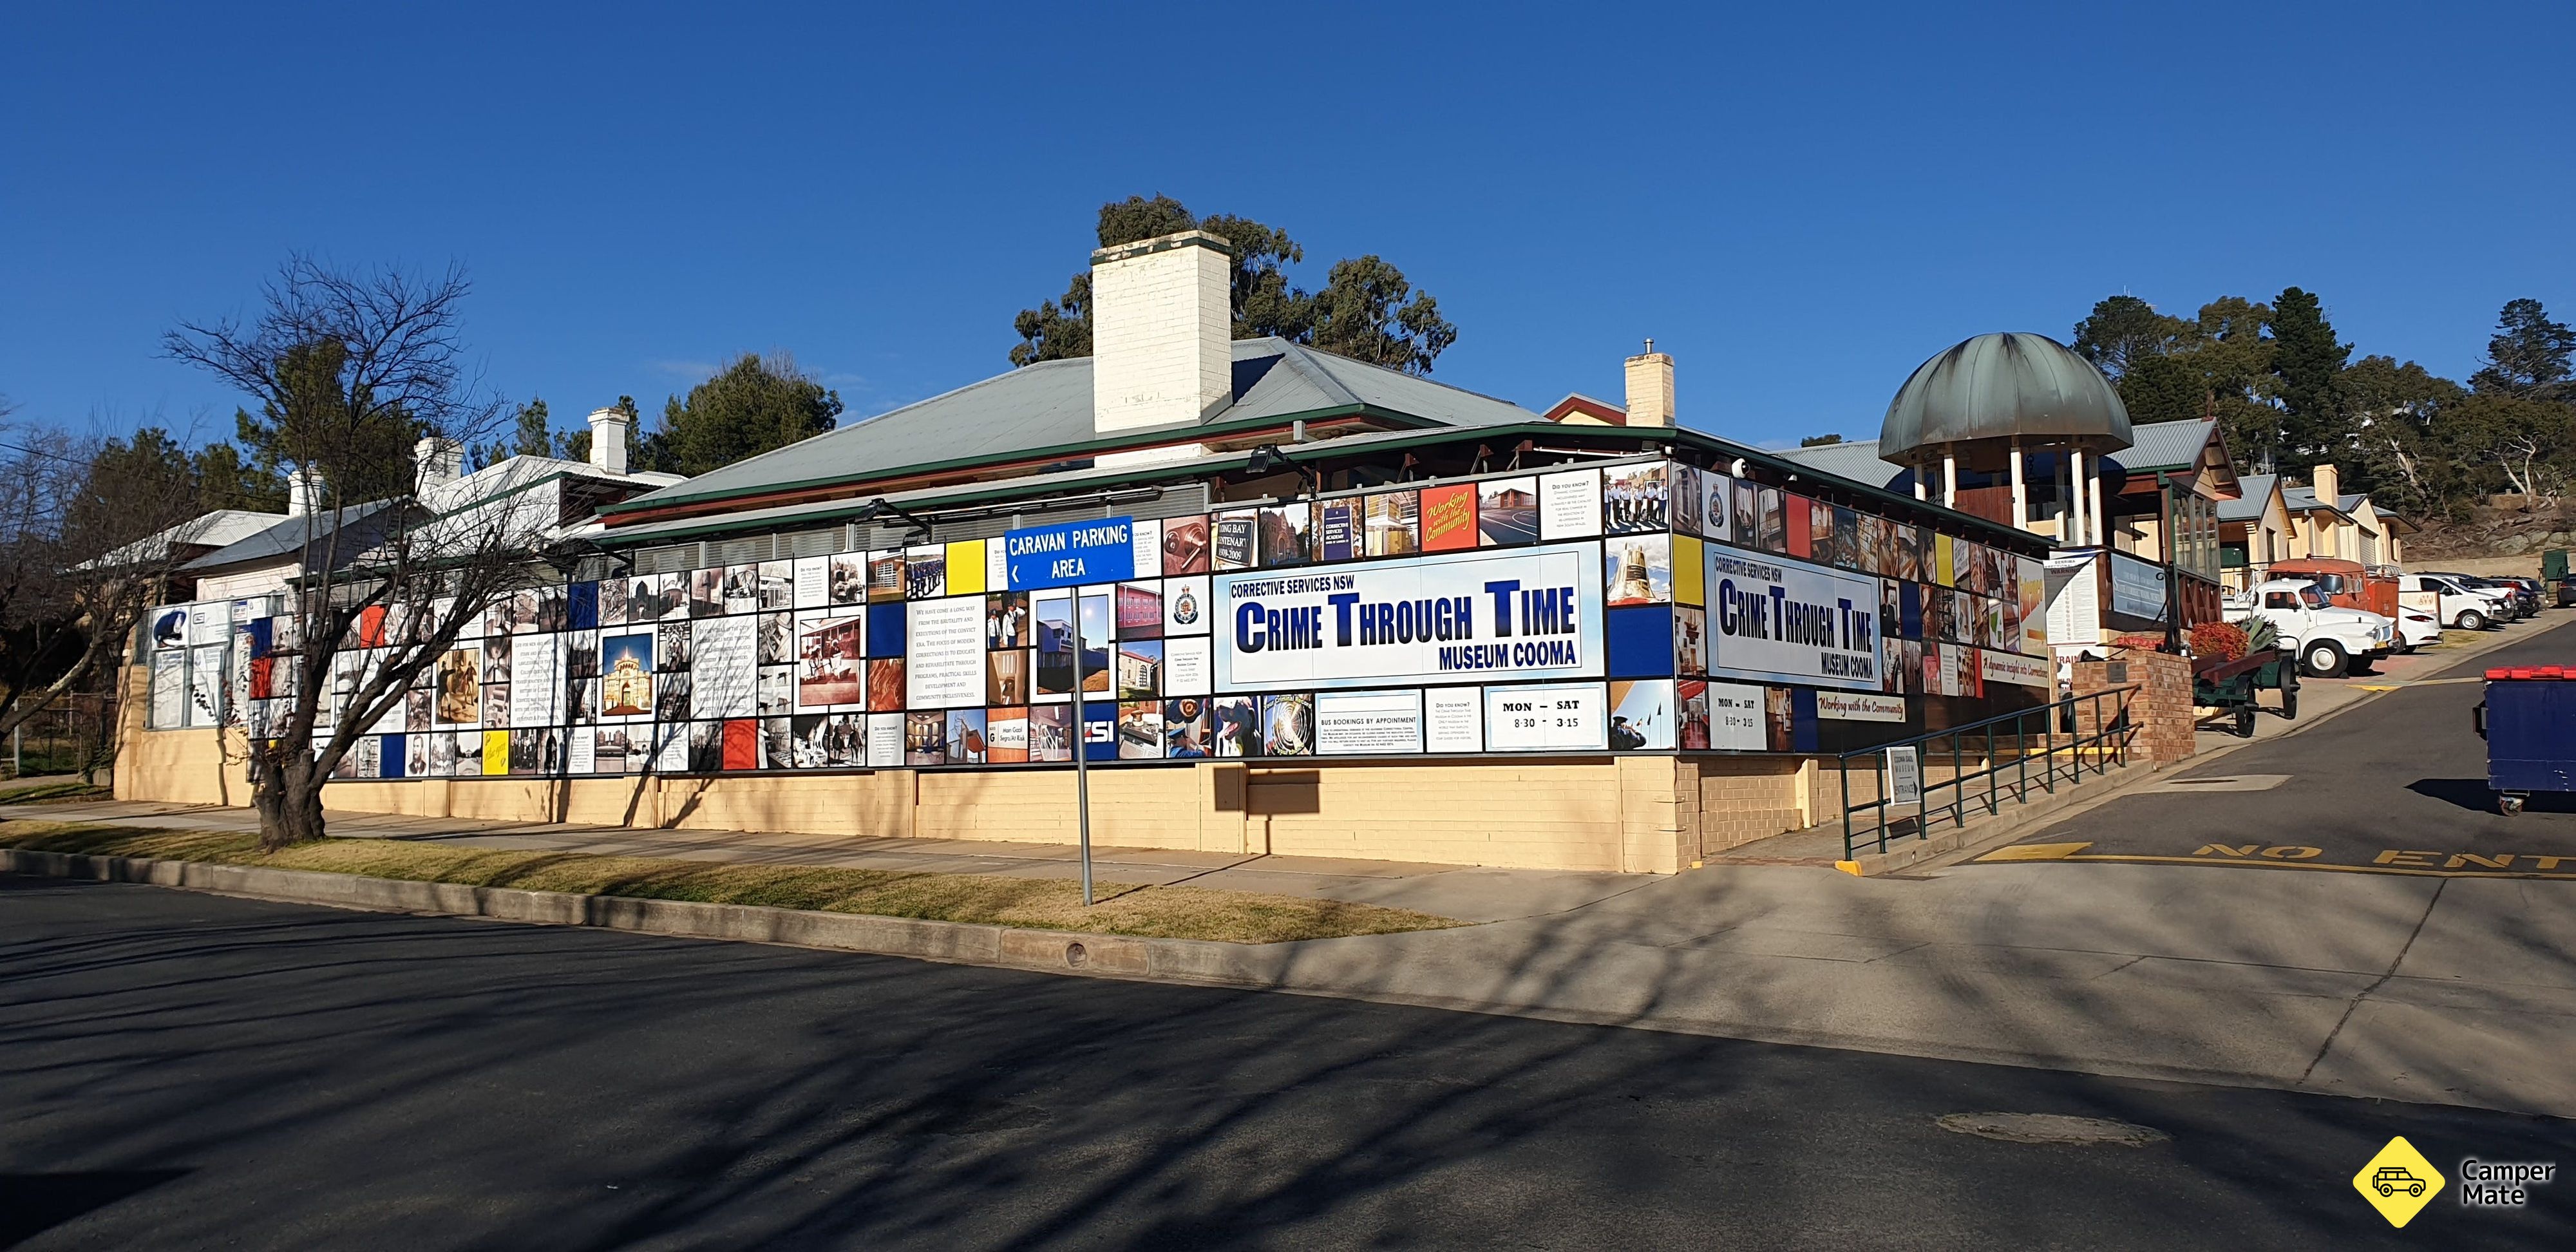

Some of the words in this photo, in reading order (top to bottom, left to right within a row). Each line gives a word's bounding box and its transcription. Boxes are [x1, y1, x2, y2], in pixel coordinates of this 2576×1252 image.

[1426, 491, 1468, 519] Working
[1434, 510, 1448, 527] with
[1450, 506, 1461, 519] the
[1220, 524, 1232, 533] LONG
[1232, 524, 1247, 534] BAY
[1426, 508, 1470, 542] Community
[1010, 532, 1066, 556] CARAVAN
[1073, 524, 1128, 549] PARKING
[1052, 558, 1086, 579] AREA
[1715, 556, 1747, 577] CORRECTIVE
[1747, 562, 1770, 582] SERVICES
[1770, 567, 1783, 583] NSW
[1231, 582, 1285, 599] CORRECTIVE
[1287, 578, 1331, 594] SERVICES
[1332, 574, 1354, 590] NSW
[1439, 644, 1509, 670] MUSEUM
[1513, 640, 1577, 667] COOMA
[1821, 652, 1849, 677] MUSEUM
[1850, 655, 1873, 679] COOMA
[1503, 703, 1532, 712] MON
[1557, 700, 1579, 709] SAT
[1718, 698, 1732, 708] MON
[1744, 699, 1754, 709] SAT
[1819, 696, 1847, 717] Working
[1848, 697, 1861, 712] with
[1862, 698, 1871, 712] the
[1871, 701, 1903, 721] Community
[989, 733, 995, 743] G
[1895, 764, 1915, 773] MUSEUM
[2192, 844, 2323, 859] NO
